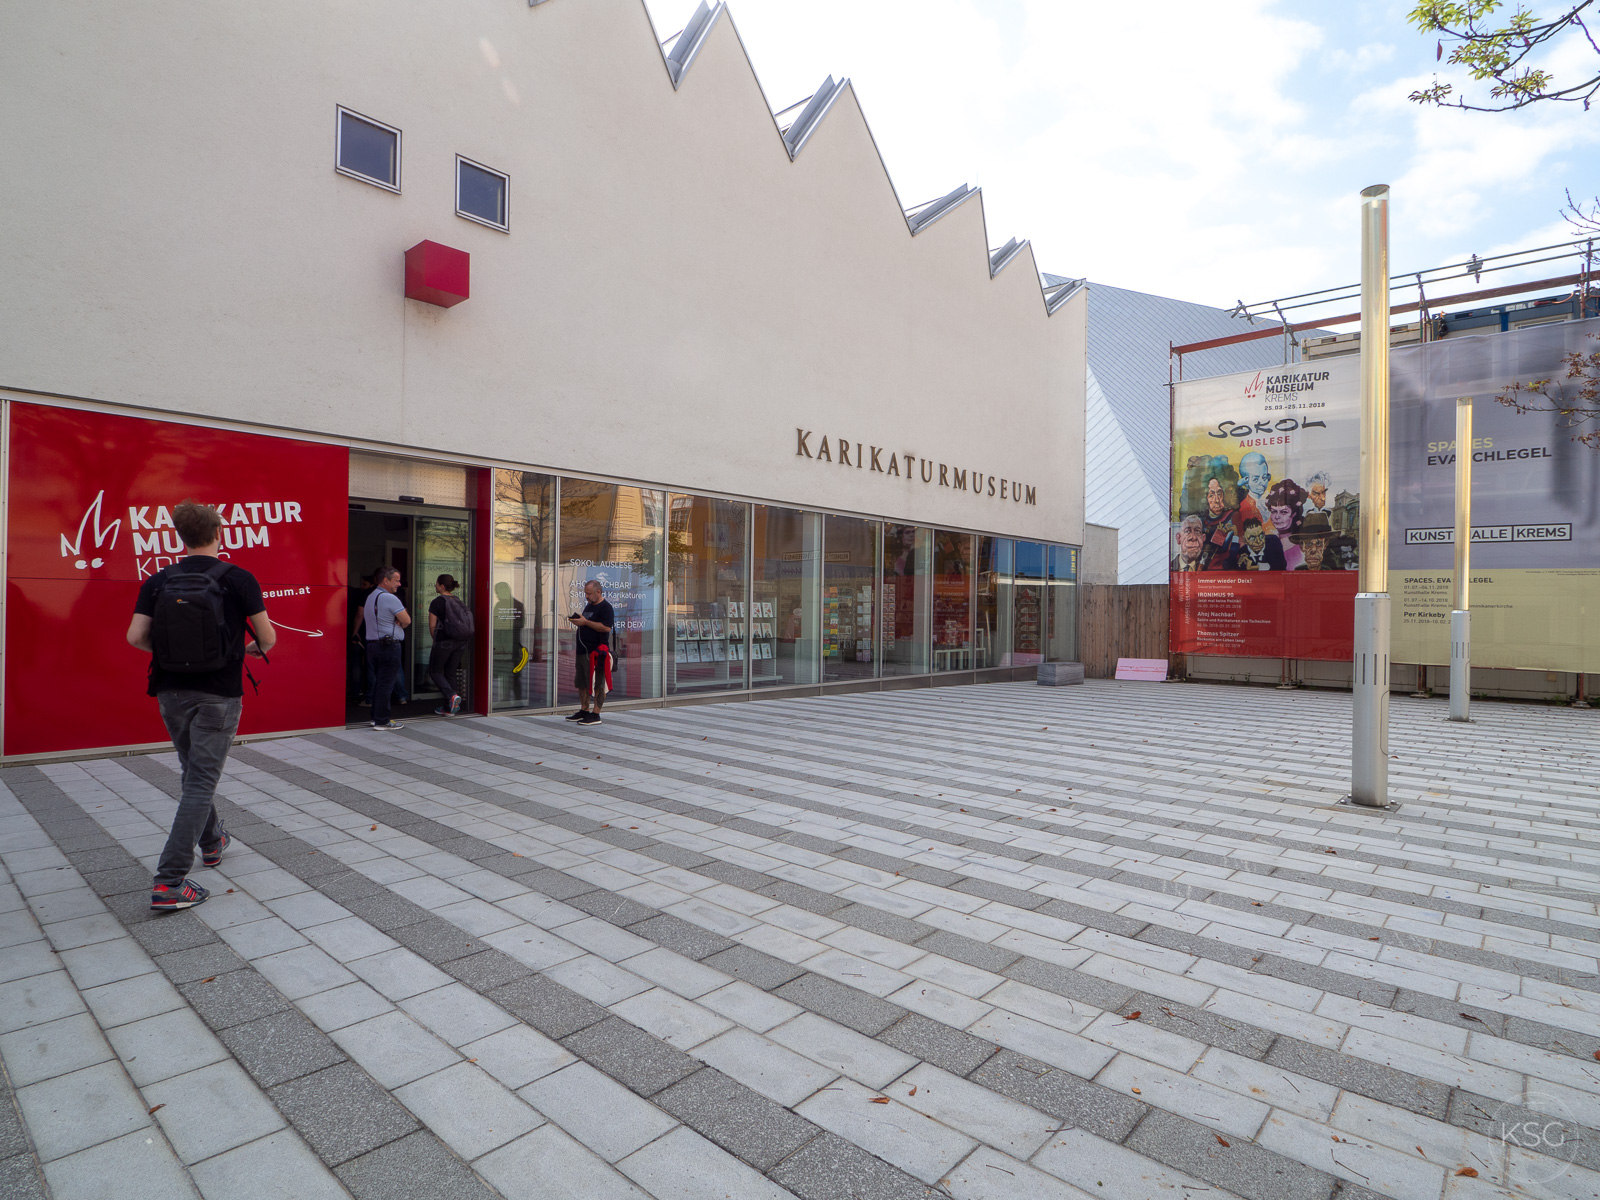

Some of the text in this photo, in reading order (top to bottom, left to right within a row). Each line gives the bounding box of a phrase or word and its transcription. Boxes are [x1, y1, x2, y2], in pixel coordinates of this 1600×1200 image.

[1267, 372, 1330, 384] KARIKATUR
[1266, 382, 1314, 393] MUSEUM
[1265, 392, 1298, 402] KREMS
[1208, 416, 1326, 438] SOKOL
[1239, 436, 1290, 448] AUSLESE
[1428, 437, 1493, 453] SPAES
[1428, 447, 1552, 466] EVA CHLEGEL
[796, 428, 1036, 506] KARIKATURMUSEUM
[1410, 527, 1566, 541] KUNST ALLE KREMS
[133, 526, 270, 556] MUUM
[570, 559, 632, 569] SOKOL AUSLESE
[600, 581, 632, 589] ACHBAR!
[607, 591, 646, 599] Karikaturen
